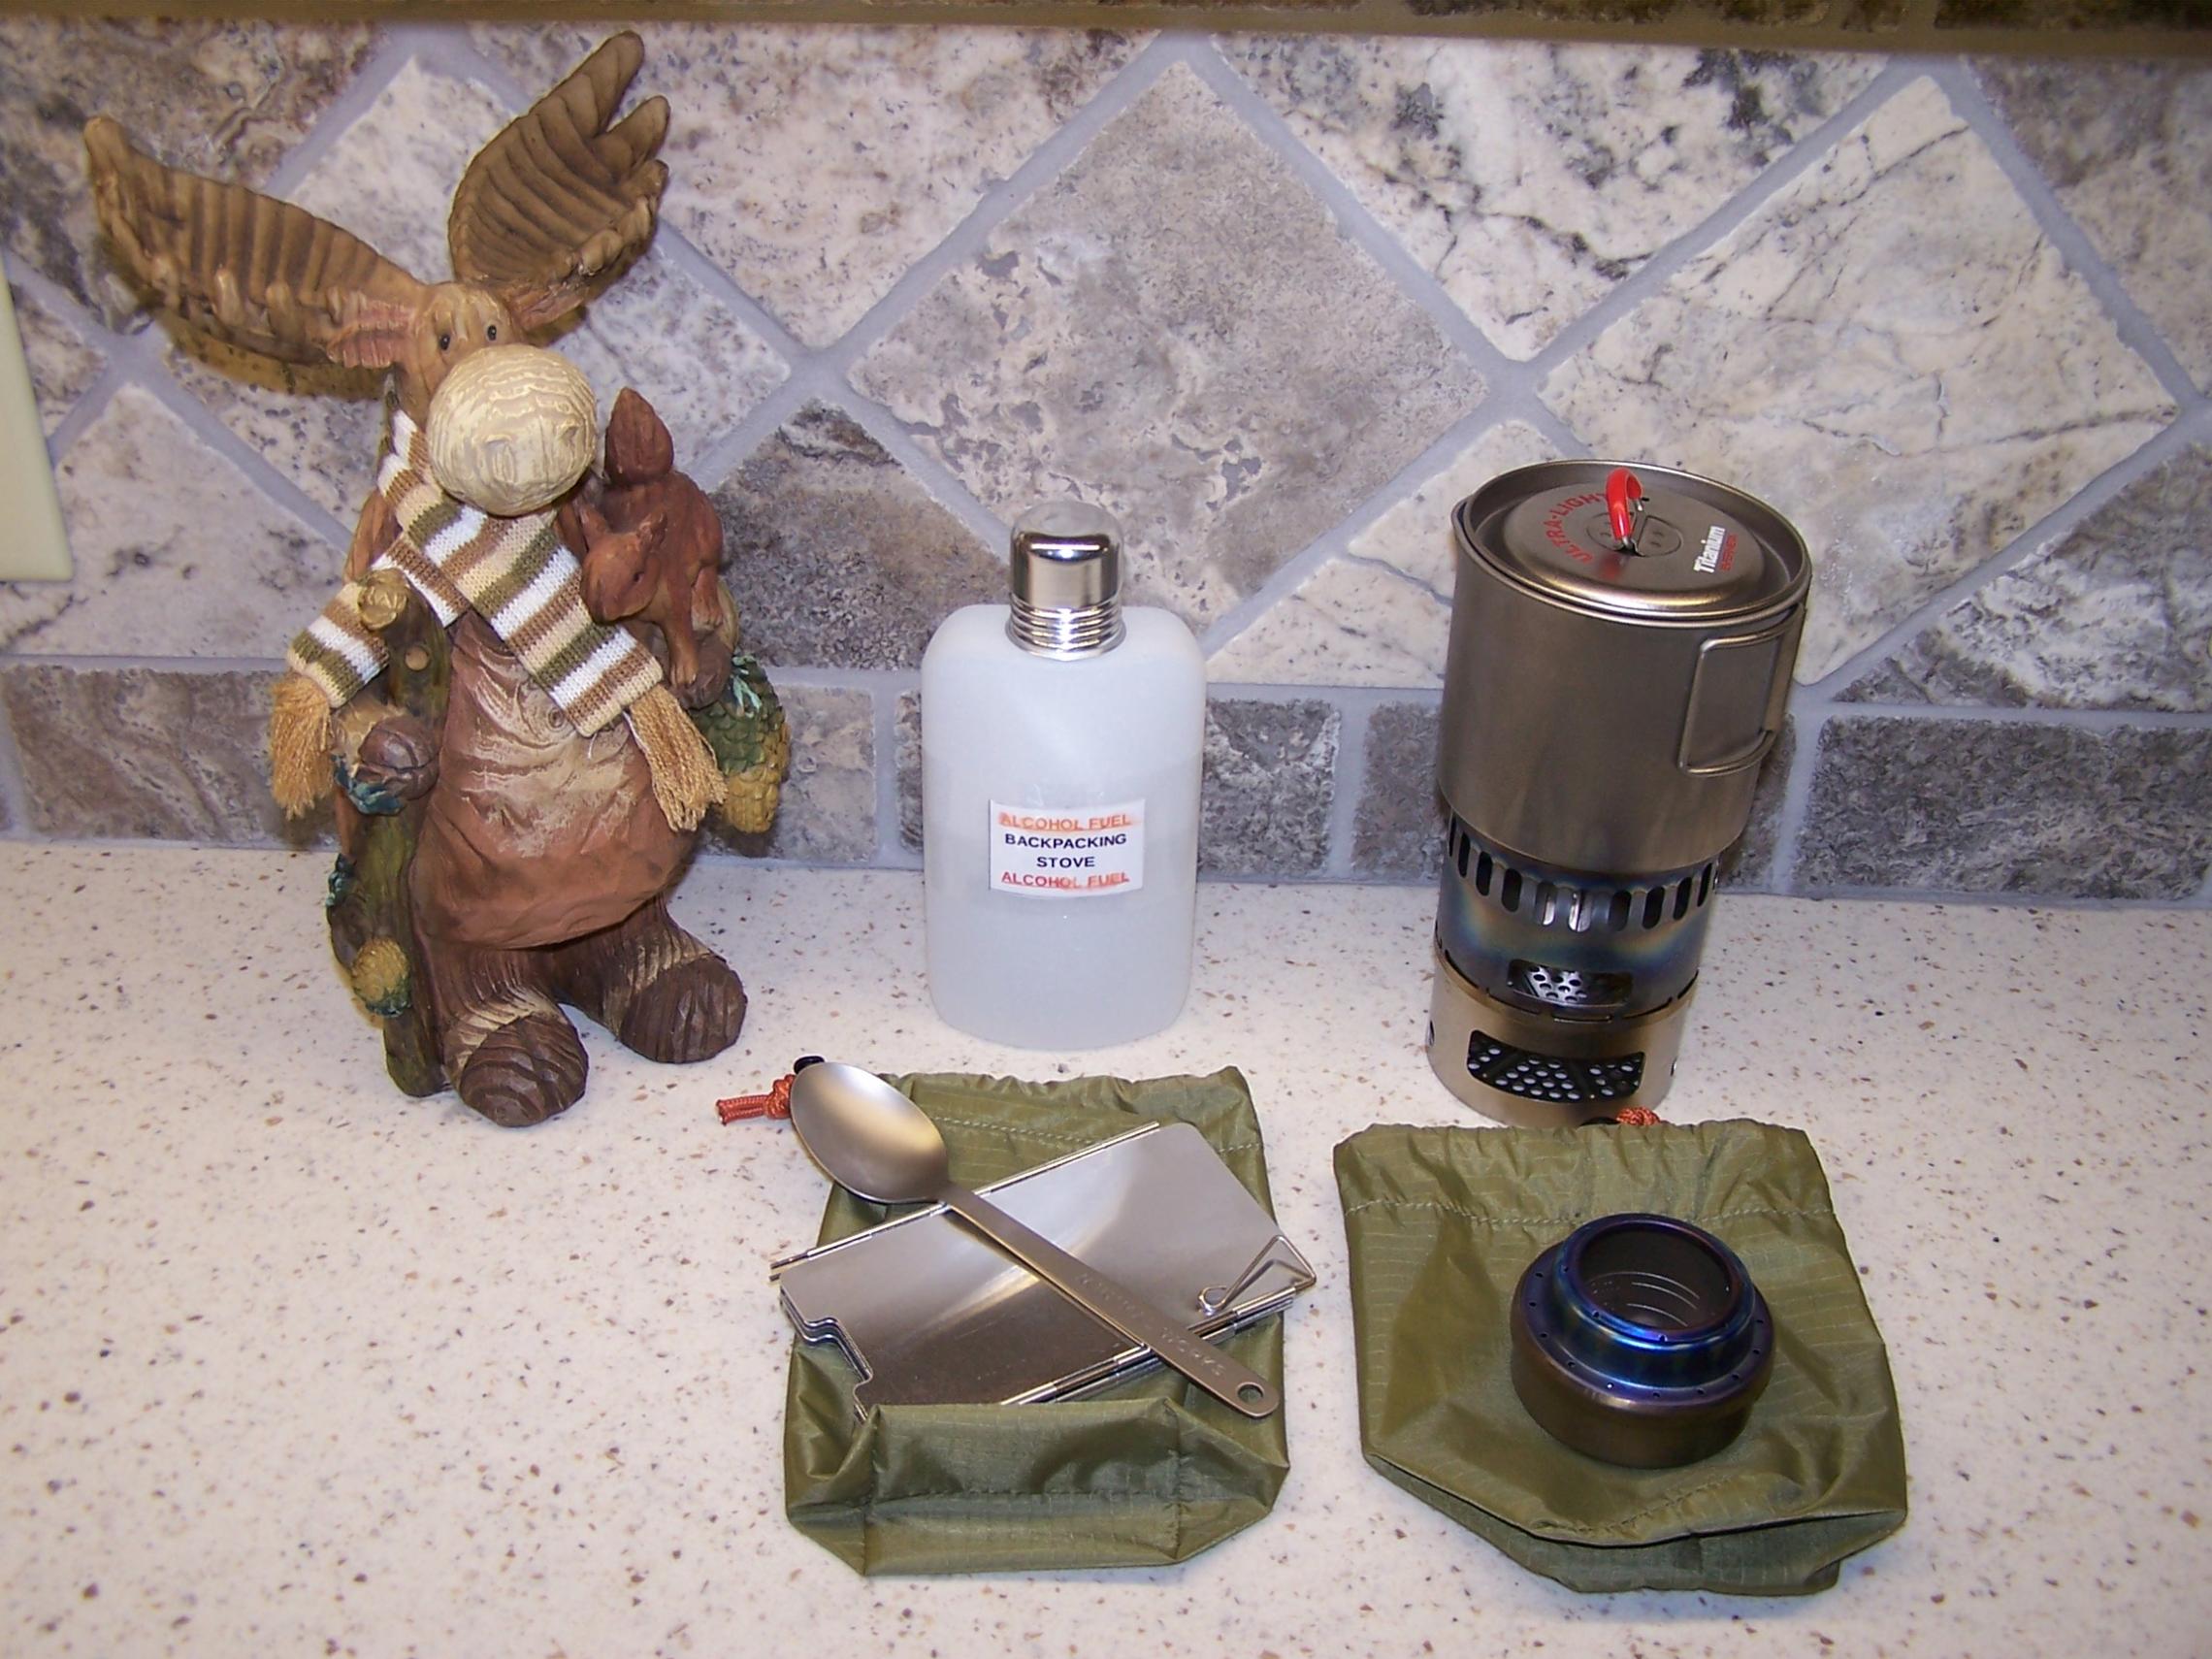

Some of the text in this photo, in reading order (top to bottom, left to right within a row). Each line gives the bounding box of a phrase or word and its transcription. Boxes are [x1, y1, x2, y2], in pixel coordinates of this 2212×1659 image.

[1693, 526, 1725, 573] Titanium
[999, 812, 1131, 831] ALCOHOL FUEL
[1004, 833, 1126, 850] BACKPACKING
[1036, 856, 1095, 868] STOVE
[1001, 871, 1129, 889] ALCOHOL FUEL
